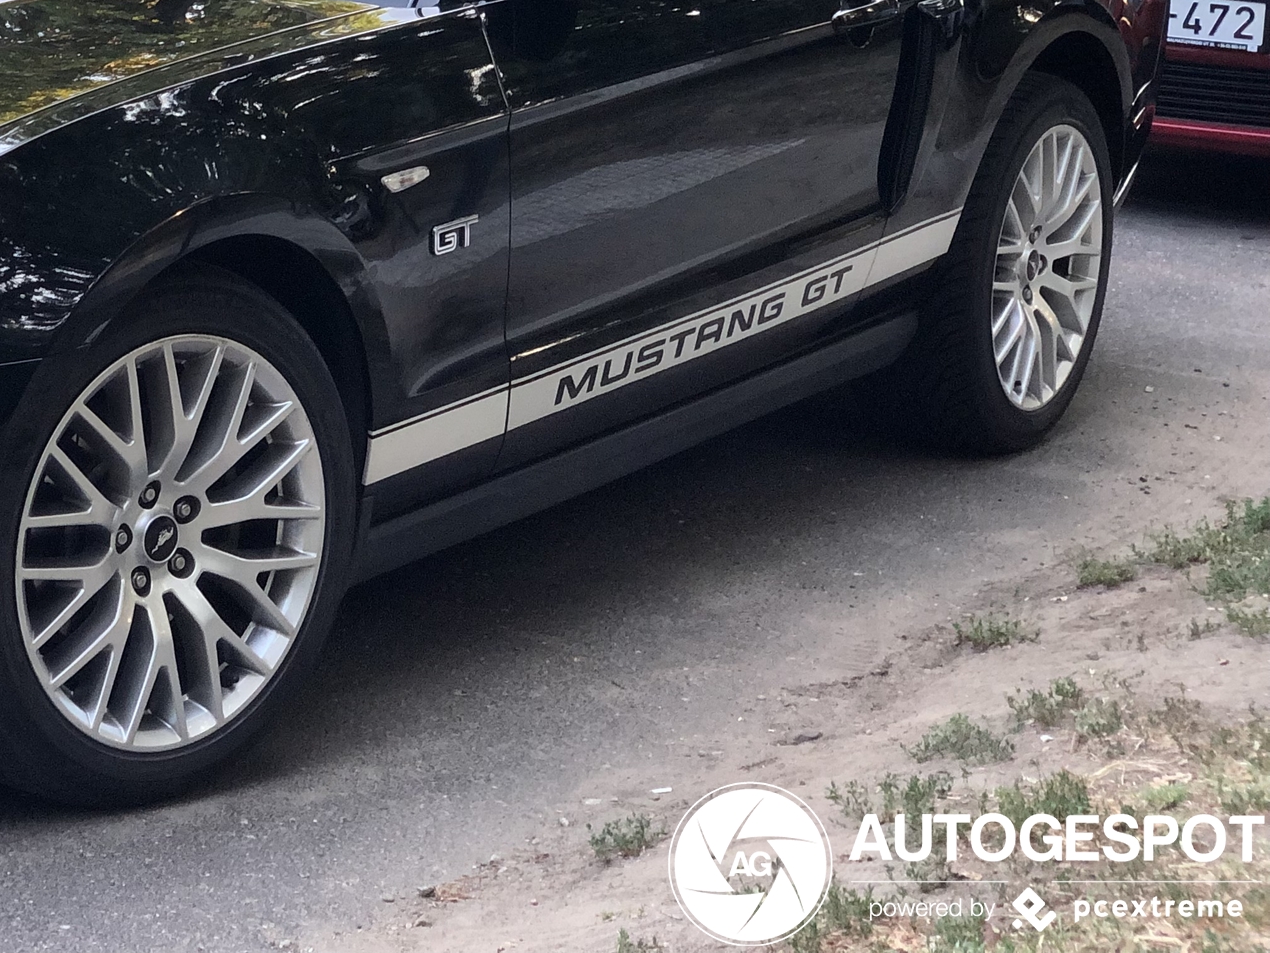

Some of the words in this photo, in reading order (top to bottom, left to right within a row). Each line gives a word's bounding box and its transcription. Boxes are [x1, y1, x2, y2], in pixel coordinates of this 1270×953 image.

[433, 214, 478, 255] GT
[554, 292, 786, 406] MUSTANG
[800, 265, 853, 307] GT
